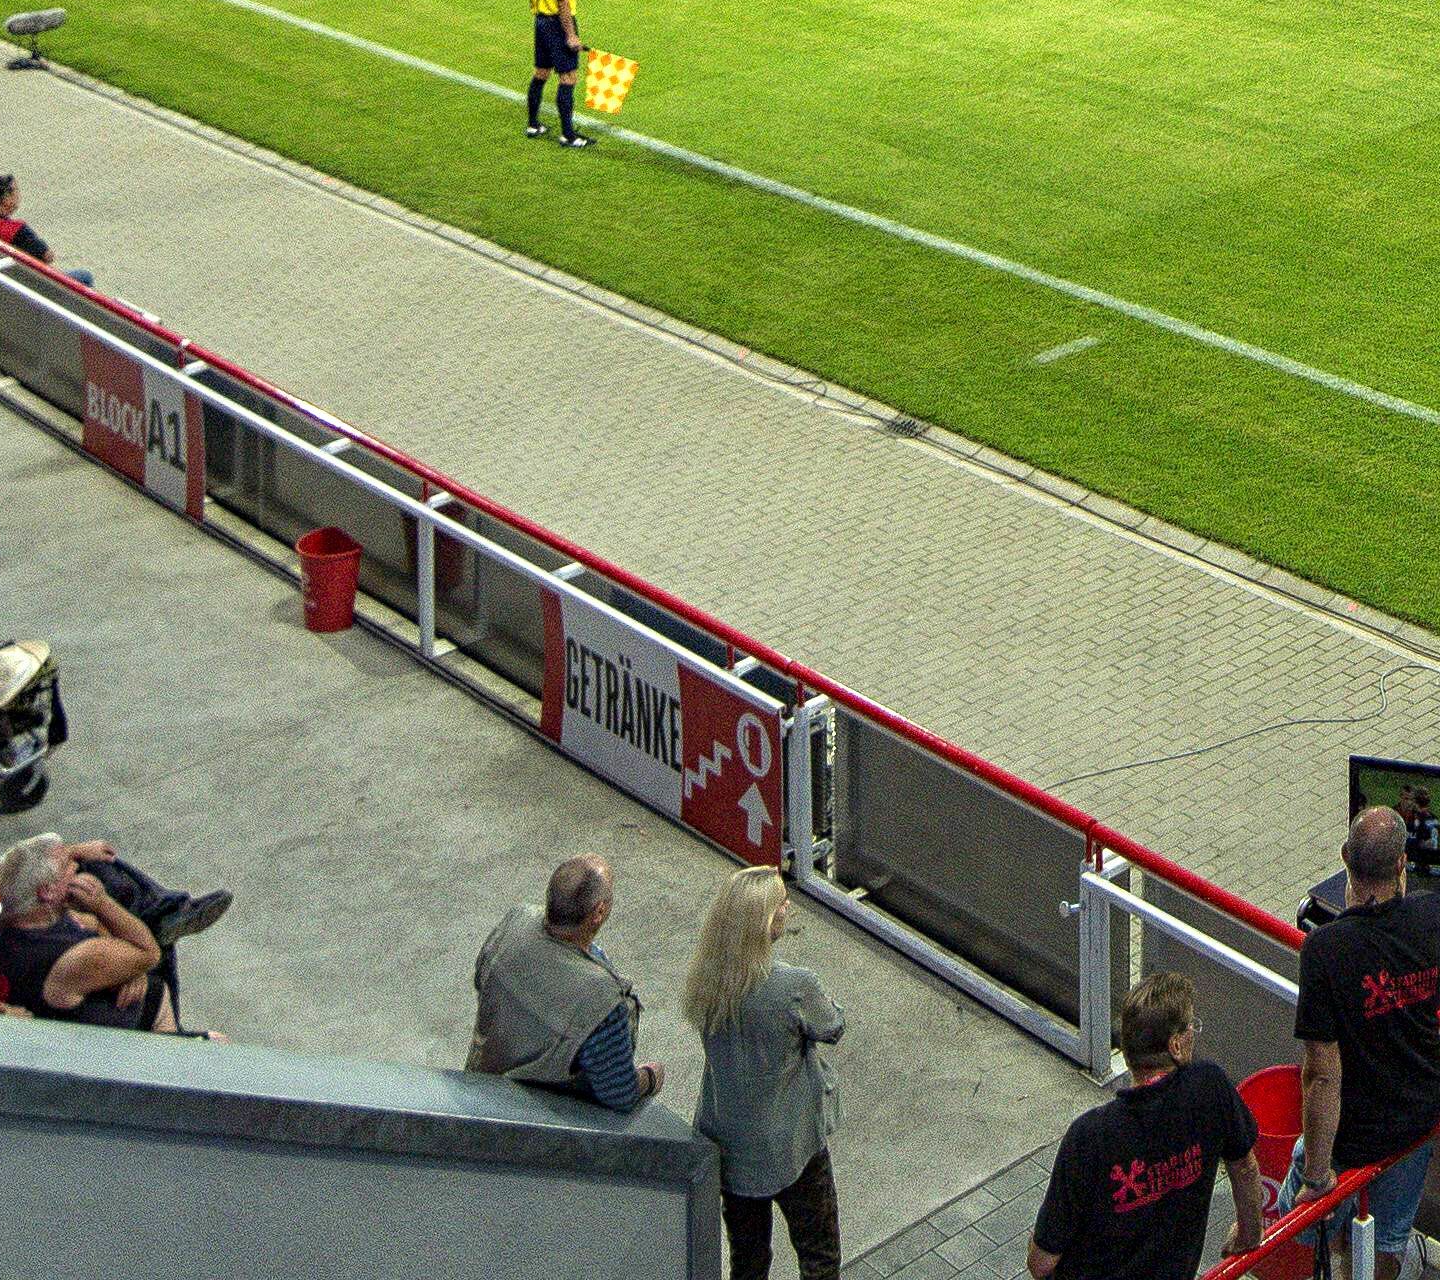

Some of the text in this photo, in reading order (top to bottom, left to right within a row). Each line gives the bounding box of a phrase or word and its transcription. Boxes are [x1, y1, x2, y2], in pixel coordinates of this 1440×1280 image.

[87, 381, 143, 447] BLOCK
[147, 398, 185, 473] A1
[566, 636, 681, 773] GETRÄNKE
